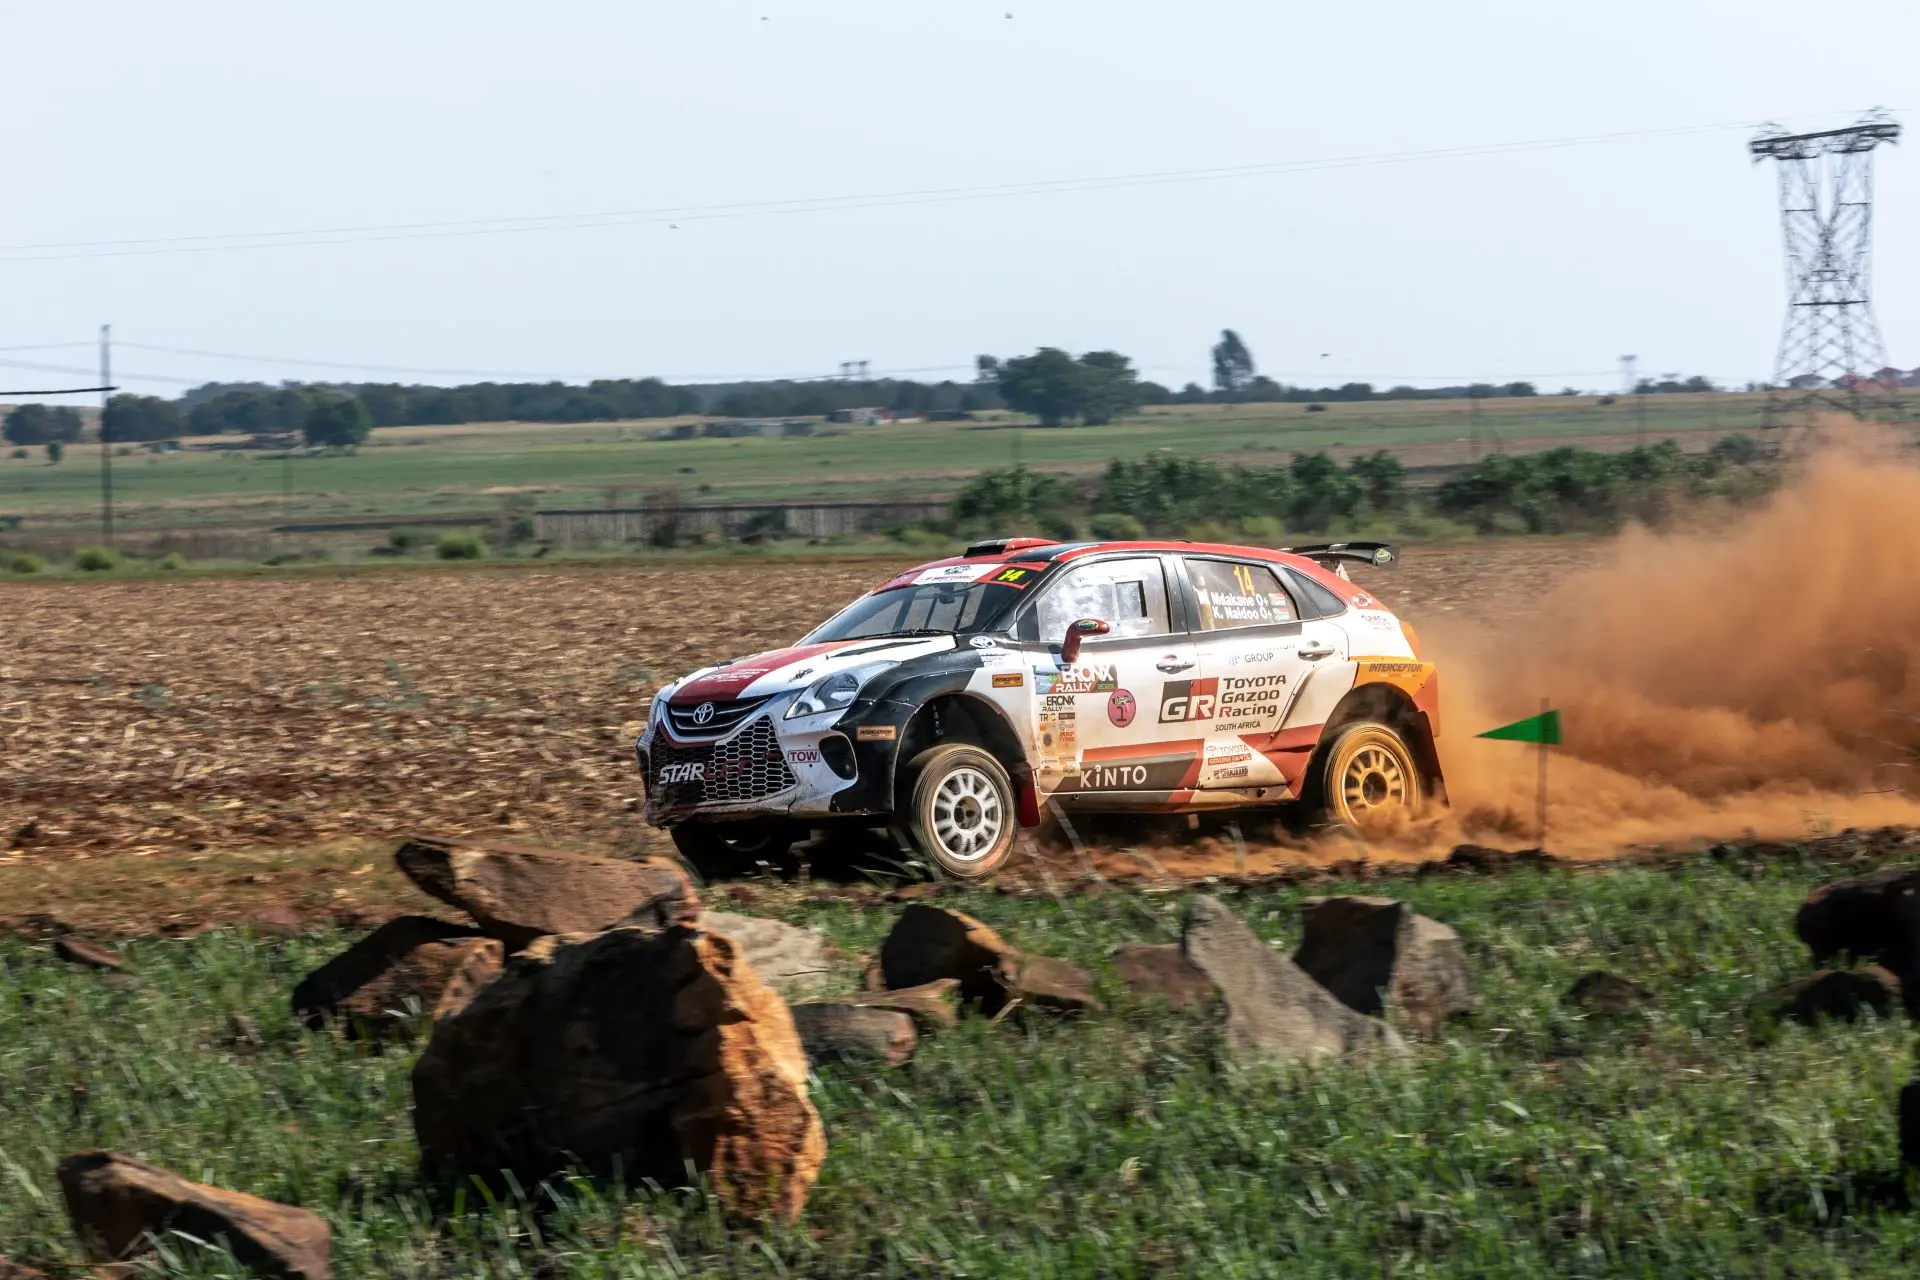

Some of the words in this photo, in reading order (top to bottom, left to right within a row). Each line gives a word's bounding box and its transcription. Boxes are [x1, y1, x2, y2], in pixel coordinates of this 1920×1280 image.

[998, 569, 1026, 581] 14
[1233, 565, 1256, 596] 14
[1210, 591, 1255, 607] Mdakane
[1256, 593, 1269, 606] O+
[1213, 606, 1224, 619] K.
[1224, 606, 1259, 620] Naidoo
[1244, 652, 1274, 663] GROUP
[1368, 663, 1423, 672] INTERCEPTOR
[1056, 682, 1092, 692] RALLY
[1222, 675, 1287, 690] TOYOTA
[1161, 694, 1216, 721] GR
[1221, 689, 1280, 704] GAZOO
[1218, 704, 1278, 718] Racing
[1116, 706, 1127, 721] 1
[1237, 721, 1261, 729] AFRICA
[790, 751, 818, 761] TOW
[1219, 744, 1250, 755] TOYOTA
[658, 758, 753, 784] STARLET
